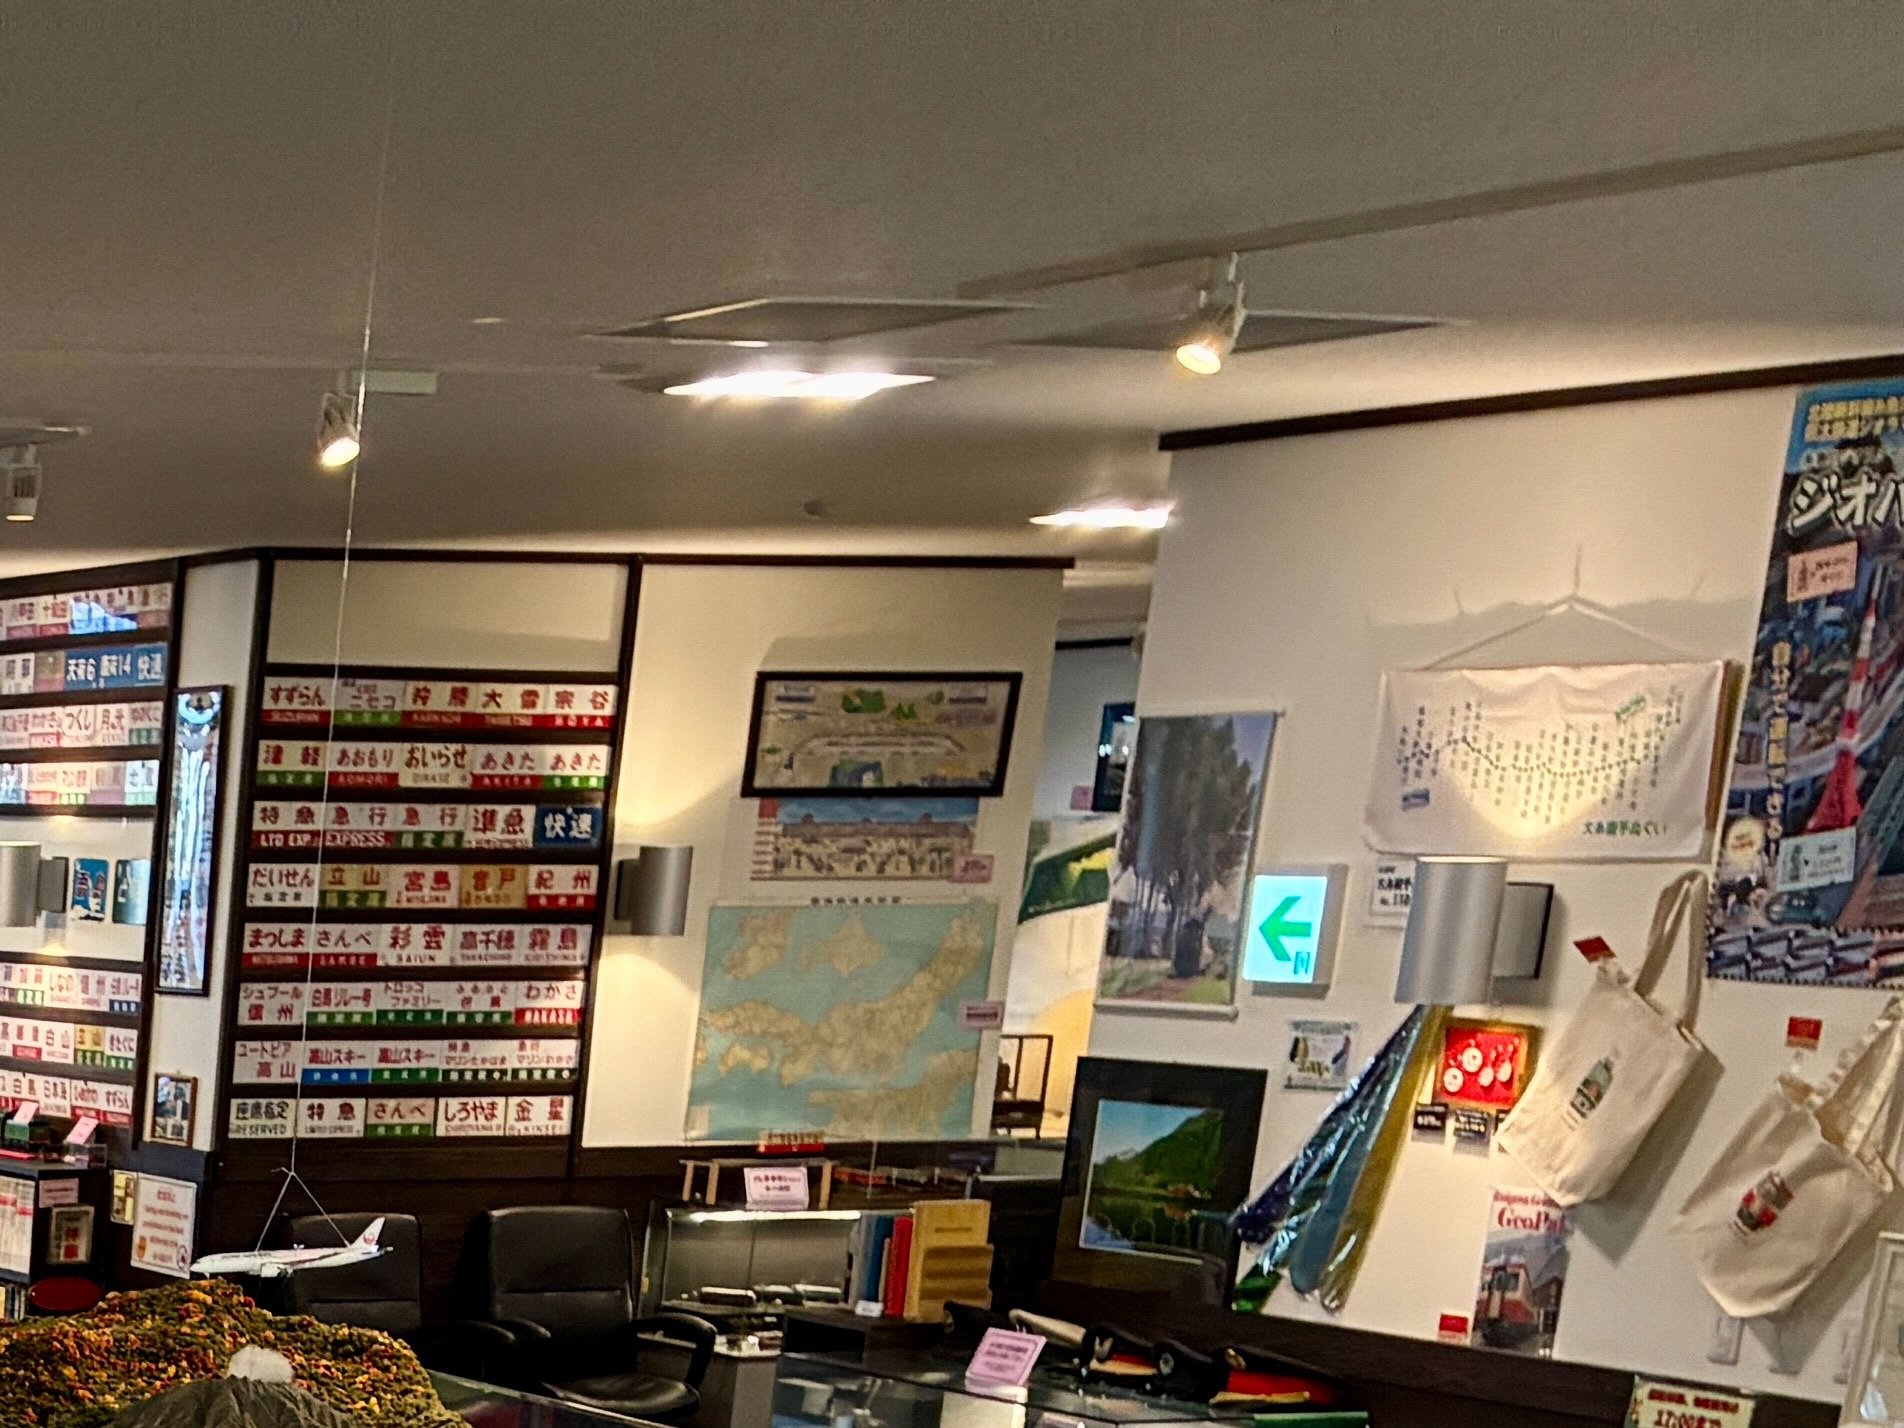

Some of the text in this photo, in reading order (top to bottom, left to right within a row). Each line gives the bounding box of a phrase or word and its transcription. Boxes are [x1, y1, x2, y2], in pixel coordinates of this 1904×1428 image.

[270, 684, 326, 707] すずらん
[337, 748, 394, 768] あおもり
[405, 745, 467, 768] おいらせ
[480, 752, 535, 770] あきた
[550, 753, 601, 770] あきた
[332, 806, 387, 825] 急行
[403, 807, 458, 826] 急行
[325, 832, 385, 847] EXPRESS
[252, 867, 314, 888] だいせん
[328, 867, 380, 886] 立山
[249, 928, 304, 948] まつしま
[317, 929, 372, 948] さんべ
[526, 983, 577, 1000] わかさ
[374, 1103, 426, 1118] さんべ
[444, 1100, 499, 1122] しろやま
